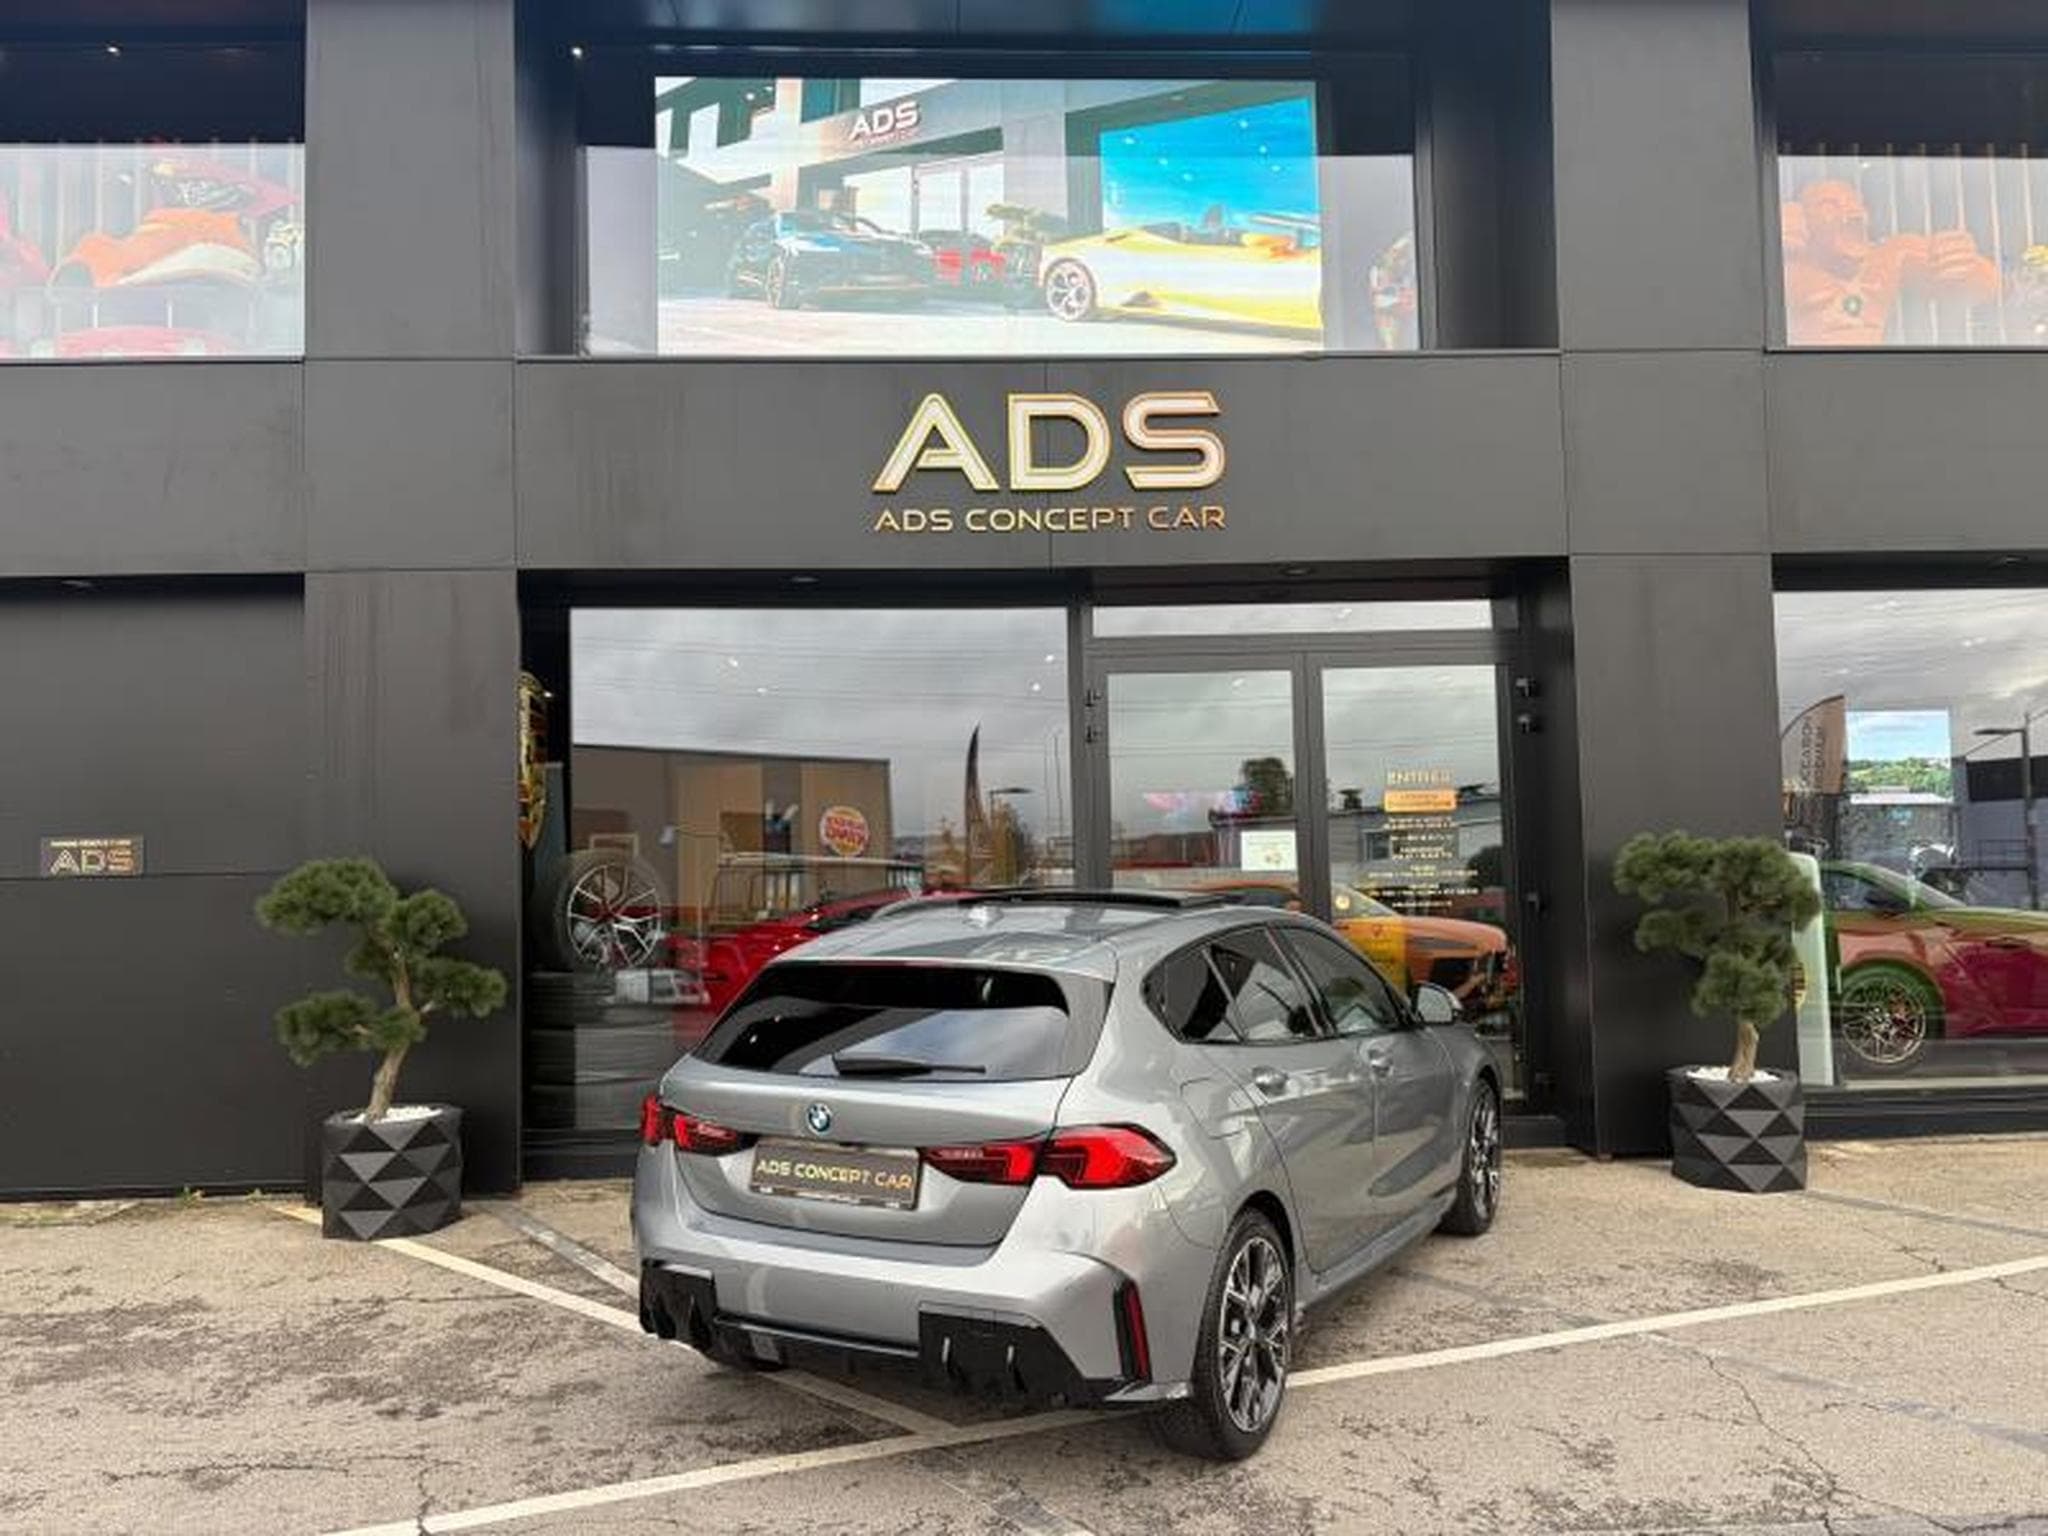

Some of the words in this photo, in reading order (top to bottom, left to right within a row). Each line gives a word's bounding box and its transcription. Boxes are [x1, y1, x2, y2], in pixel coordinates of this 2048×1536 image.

[849, 101, 918, 141] ADS
[872, 391, 1226, 492] ADS
[873, 508, 955, 533] ADS
[965, 507, 1135, 533] CONCEPT
[1148, 505, 1227, 531] CAR
[49, 848, 134, 875] ADS
[756, 1159, 792, 1177] ADS
[794, 1162, 872, 1185] CONCEPT
[874, 1171, 913, 1190] CAR
